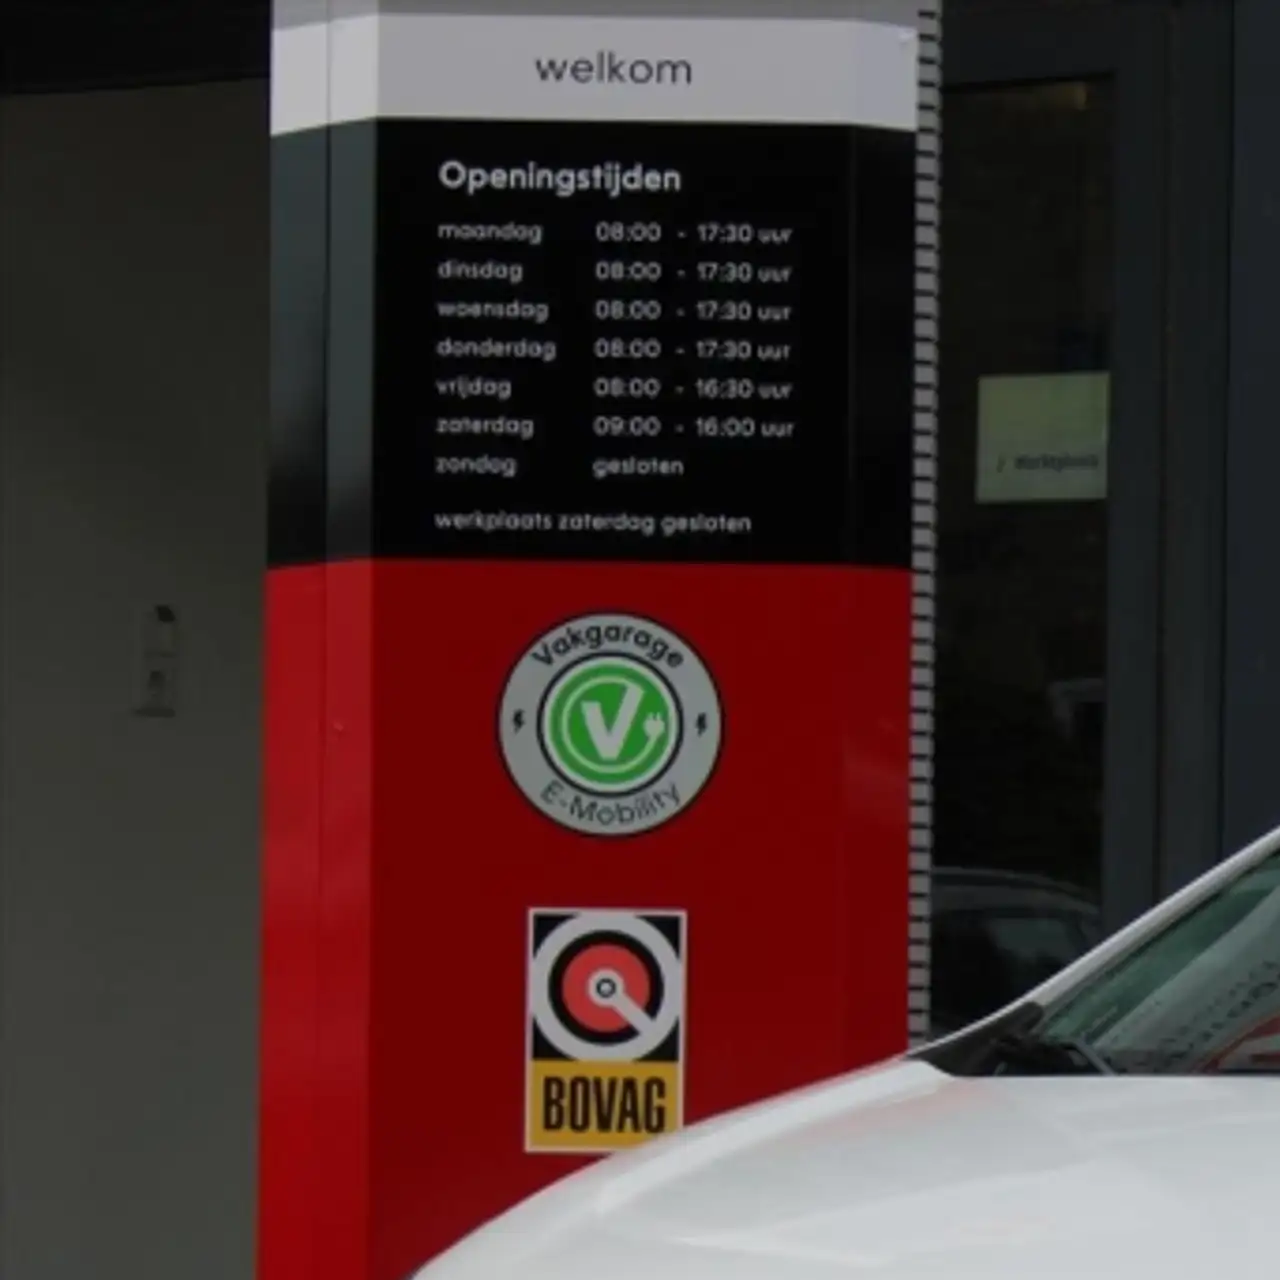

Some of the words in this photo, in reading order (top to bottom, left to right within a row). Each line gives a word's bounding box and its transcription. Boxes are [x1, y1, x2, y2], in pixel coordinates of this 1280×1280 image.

[535, 51, 692, 86] welkom
[438, 160, 681, 198] Openingstijden
[437, 221, 543, 245] maandag
[596, 221, 662, 242] 08:00
[697, 222, 753, 243] 17:30
[757, 227, 792, 243] uur
[437, 259, 524, 284] dinsdag
[596, 260, 662, 281] 08:00
[697, 261, 753, 282] 17:30
[757, 267, 791, 283] uur
[436, 299, 549, 324] woensdag
[595, 299, 662, 320] 08:00
[696, 300, 752, 321] 17:30
[757, 306, 791, 321] uur
[436, 337, 557, 362] donderdag
[595, 337, 661, 359] 08:00
[696, 339, 752, 360] 17:30
[757, 345, 791, 361] uur
[436, 376, 512, 400] vrijdag
[594, 376, 661, 398] 08:00
[695, 378, 752, 399] 16:30
[757, 383, 792, 399] uur
[436, 416, 535, 440] zaterdag
[593, 416, 661, 437] 09:00
[696, 417, 754, 438] 16:00
[761, 421, 794, 437] uur
[436, 454, 517, 478] zondag
[593, 456, 685, 479] gesloten
[435, 510, 552, 534] werkplaats
[558, 512, 655, 537] zaterdag
[661, 513, 752, 537] gesloten
[530, 619, 686, 668] Vakgarage
[540, 779, 684, 827] E-Mobility
[543, 1075, 667, 1135] BOVAG
